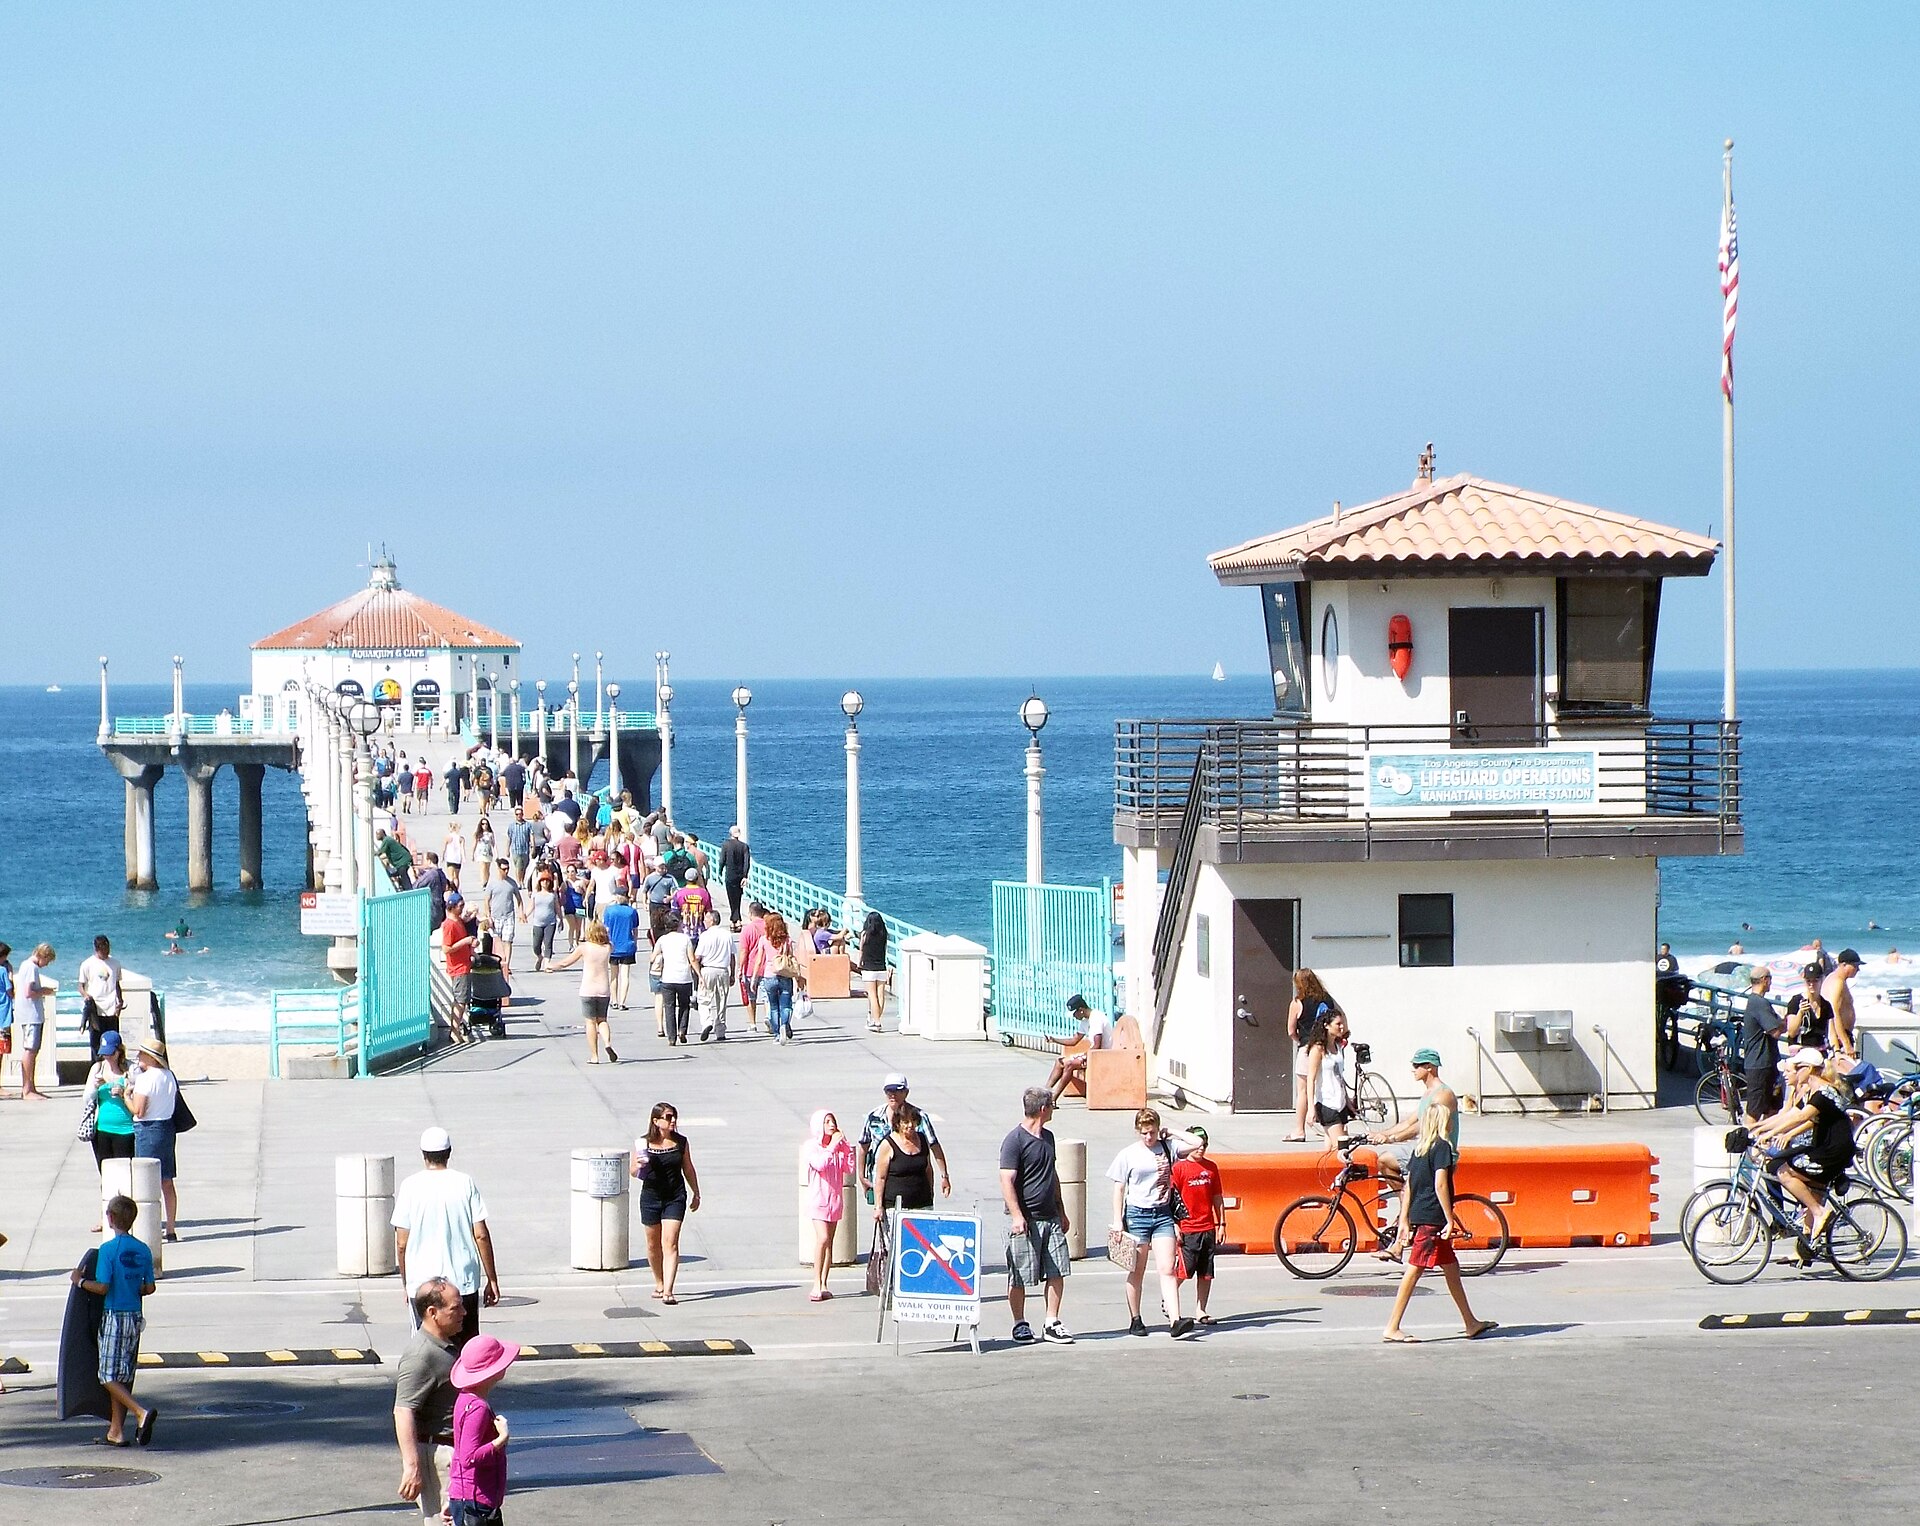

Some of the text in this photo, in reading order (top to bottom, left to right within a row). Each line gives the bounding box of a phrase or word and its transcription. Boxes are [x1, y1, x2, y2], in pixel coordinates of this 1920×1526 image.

[351, 649, 391, 659] AQUARIUM
[416, 684, 436, 692] CAFE
[1425, 757, 1586, 769] Los Angeles County Fire Department
[1420, 767, 1591, 787] LIFEGUARD OPERATIONS
[1420, 787, 1593, 802] MANHATTAN BEACH PIER STATION
[302, 898, 316, 906] NO
[898, 1301, 923, 1309] WALK
[928, 1303, 951, 1311] YOUR
